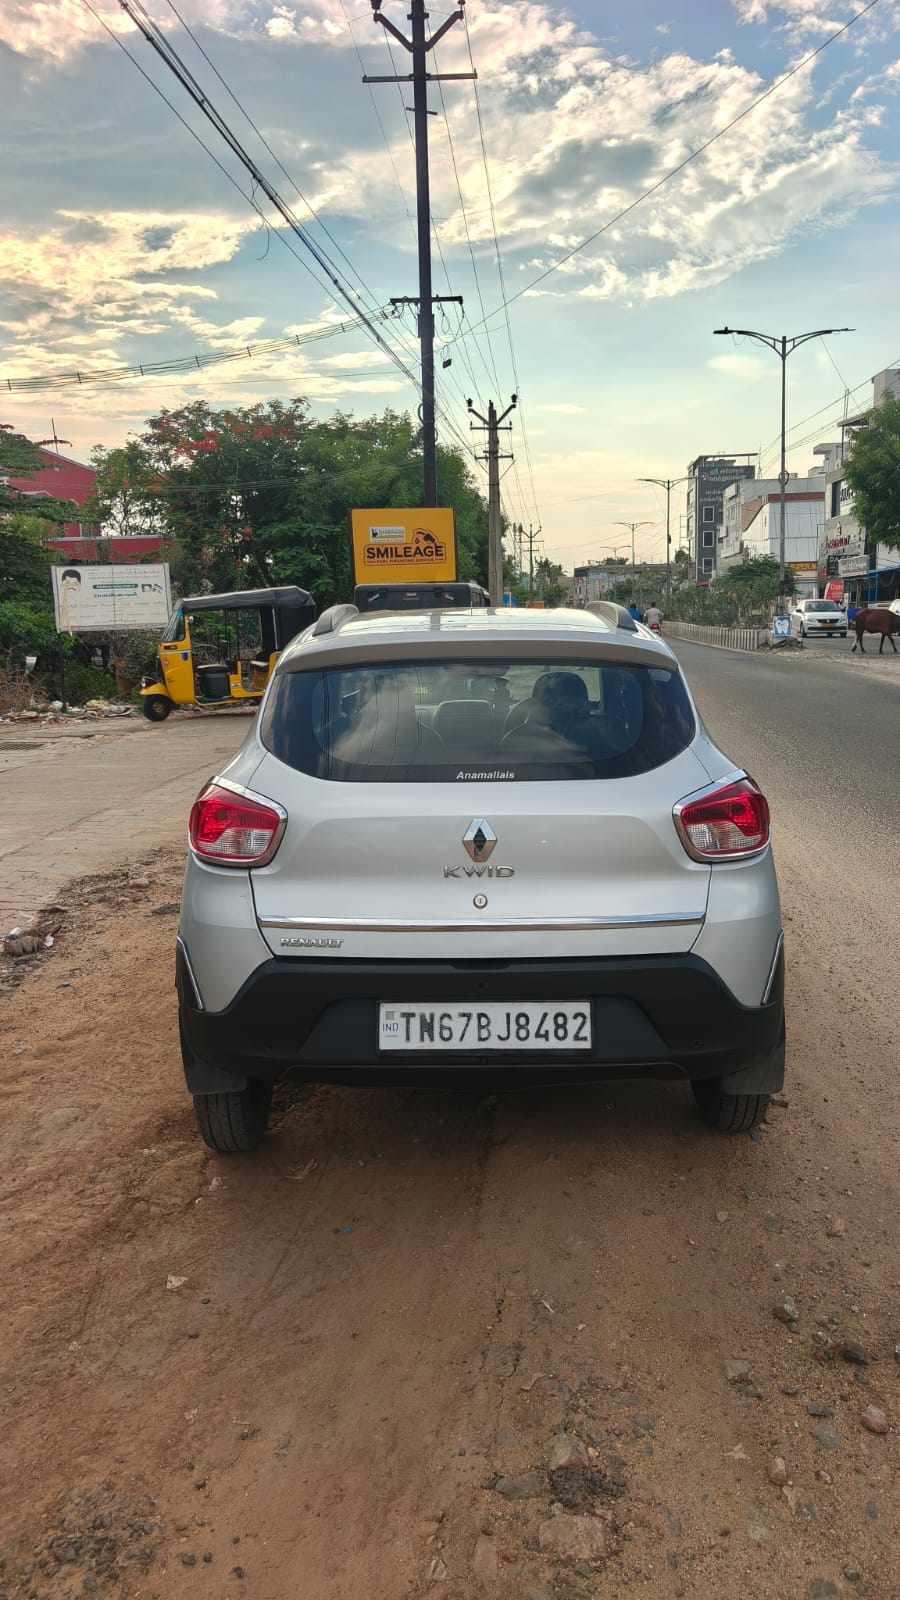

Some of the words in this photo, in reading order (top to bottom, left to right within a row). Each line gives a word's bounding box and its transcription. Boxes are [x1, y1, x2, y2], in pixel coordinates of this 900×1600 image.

[366, 545, 443, 558] SMILEAGE
[455, 770, 516, 780] Anamallais
[443, 865, 515, 878] KWID
[280, 937, 344, 948] RENAULT
[382, 1023, 399, 1032] IND
[399, 1011, 589, 1043] TN67BJ8482
